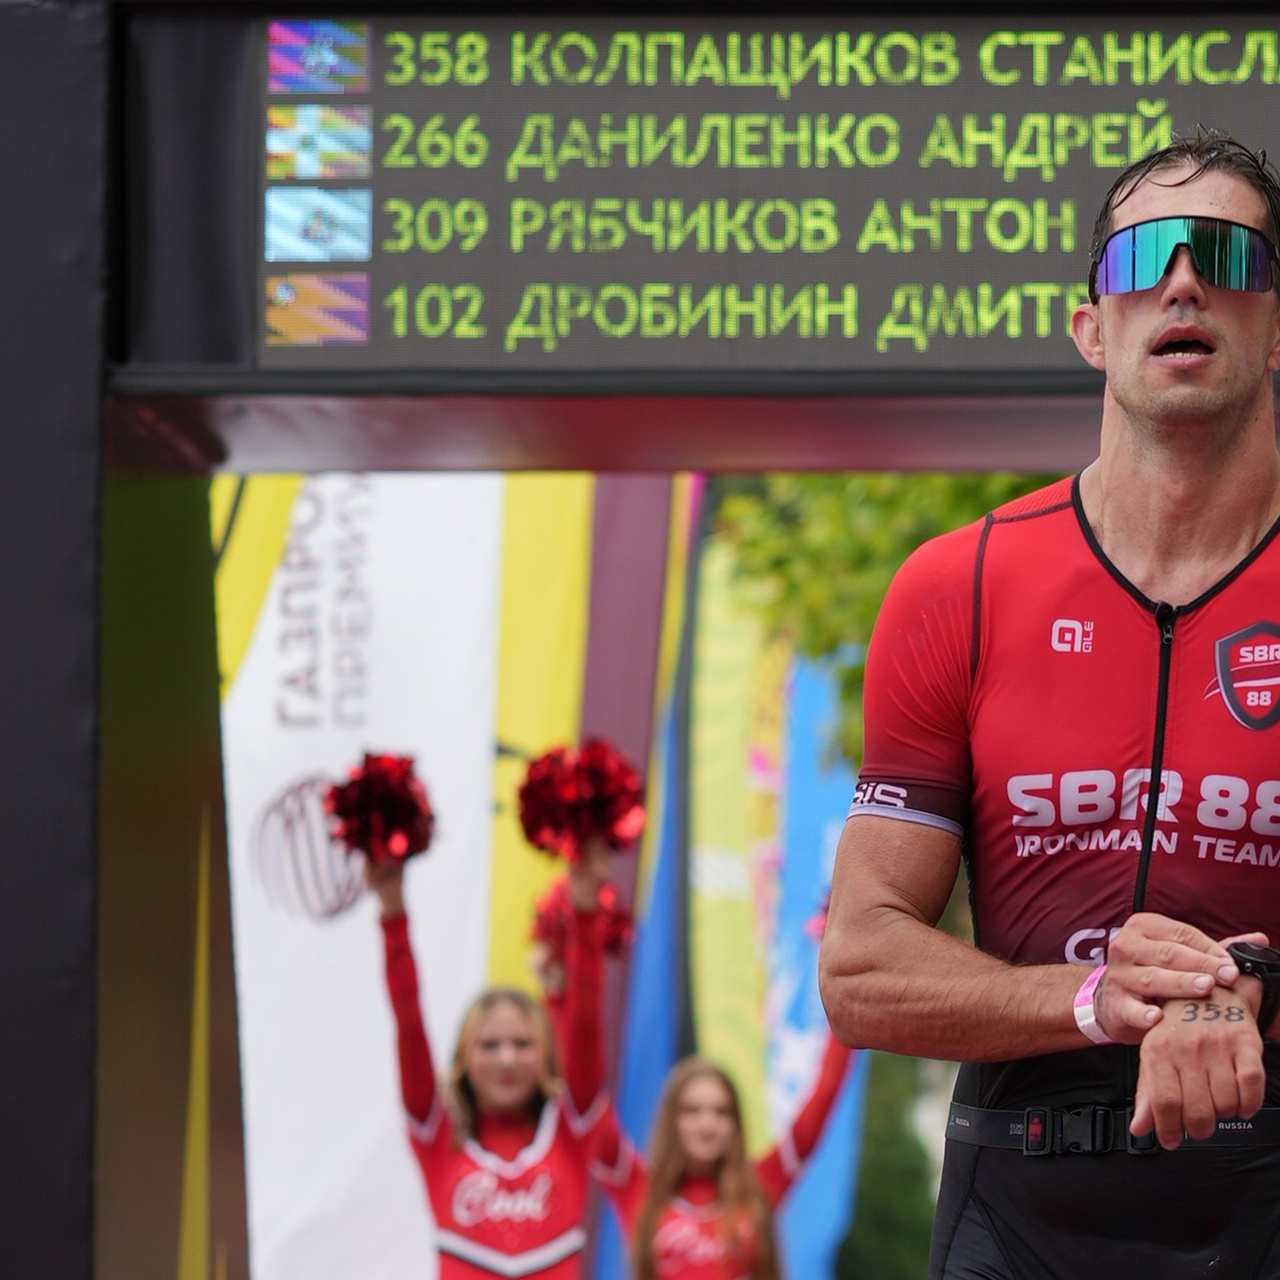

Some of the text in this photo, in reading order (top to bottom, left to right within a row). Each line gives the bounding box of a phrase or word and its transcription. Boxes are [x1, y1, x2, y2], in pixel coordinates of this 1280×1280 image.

[384, 31, 490, 86] 358
[511, 30, 961, 99] КОЛПАЩИКОВ
[382, 113, 490, 168] 266
[505, 113, 901, 181] ДАНИЛЕНКО
[918, 99, 1172, 181] АНДРЕЙ
[382, 198, 490, 252] 309
[510, 198, 841, 253] РЯБЧИКОВ
[856, 198, 1076, 253] АНТОН
[384, 283, 487, 338] 102
[504, 282, 859, 351] ДРОБИНИН
[1246, 690, 1272, 706] 88
[1007, 768, 1184, 827] SBR
[1015, 828, 1178, 858] IRONMAN
[1181, 1002, 1244, 1022] 358
[1218, 1122, 1253, 1130] RUSSIA
